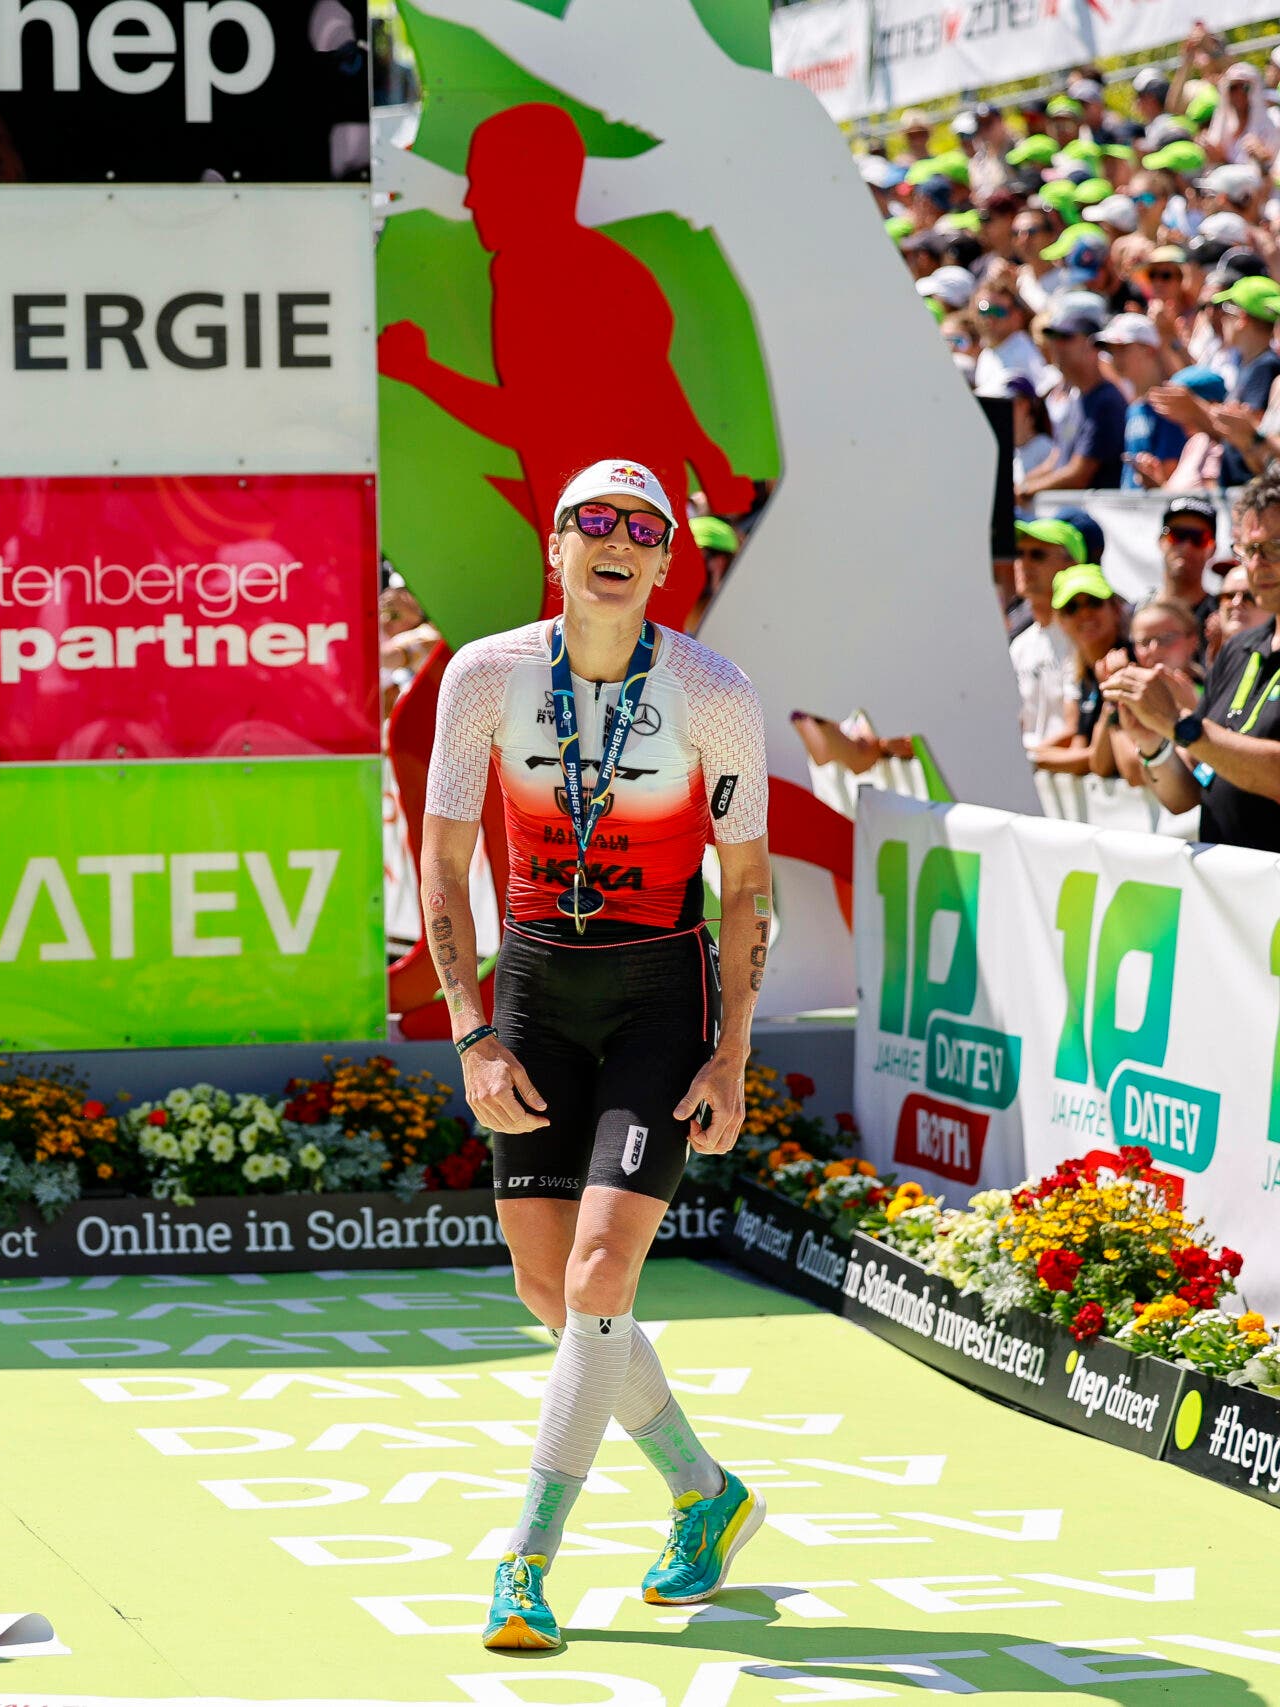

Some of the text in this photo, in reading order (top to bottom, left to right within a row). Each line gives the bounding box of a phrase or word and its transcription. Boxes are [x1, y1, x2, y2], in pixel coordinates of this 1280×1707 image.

[610, 475, 646, 489] Red Bull
[0, 613, 348, 684] partner
[536, 715, 555, 724] RY
[602, 699, 634, 780] FINISHER 2023
[566, 763, 581, 814] FINISHER
[530, 855, 644, 891] HOKA
[873, 1033, 1003, 1093] JAHRE DATEV
[916, 1108, 971, 1171] ROTH
[1052, 1085, 1201, 1155] JAHRE DATEV
[508, 1176, 534, 1188] DT
[538, 1176, 581, 1189] SWISS
[76, 1212, 234, 1256] Online
[246, 1210, 289, 1253] in
[307, 1206, 506, 1251] Solarfon
[733, 1199, 762, 1251] hep
[796, 1229, 846, 1288] Online
[841, 1248, 860, 1299] in
[858, 1260, 935, 1338] Solarfonds
[933, 1295, 1046, 1386] investieren.
[1065, 1354, 1107, 1420] hep
[1104, 1372, 1161, 1433] direct
